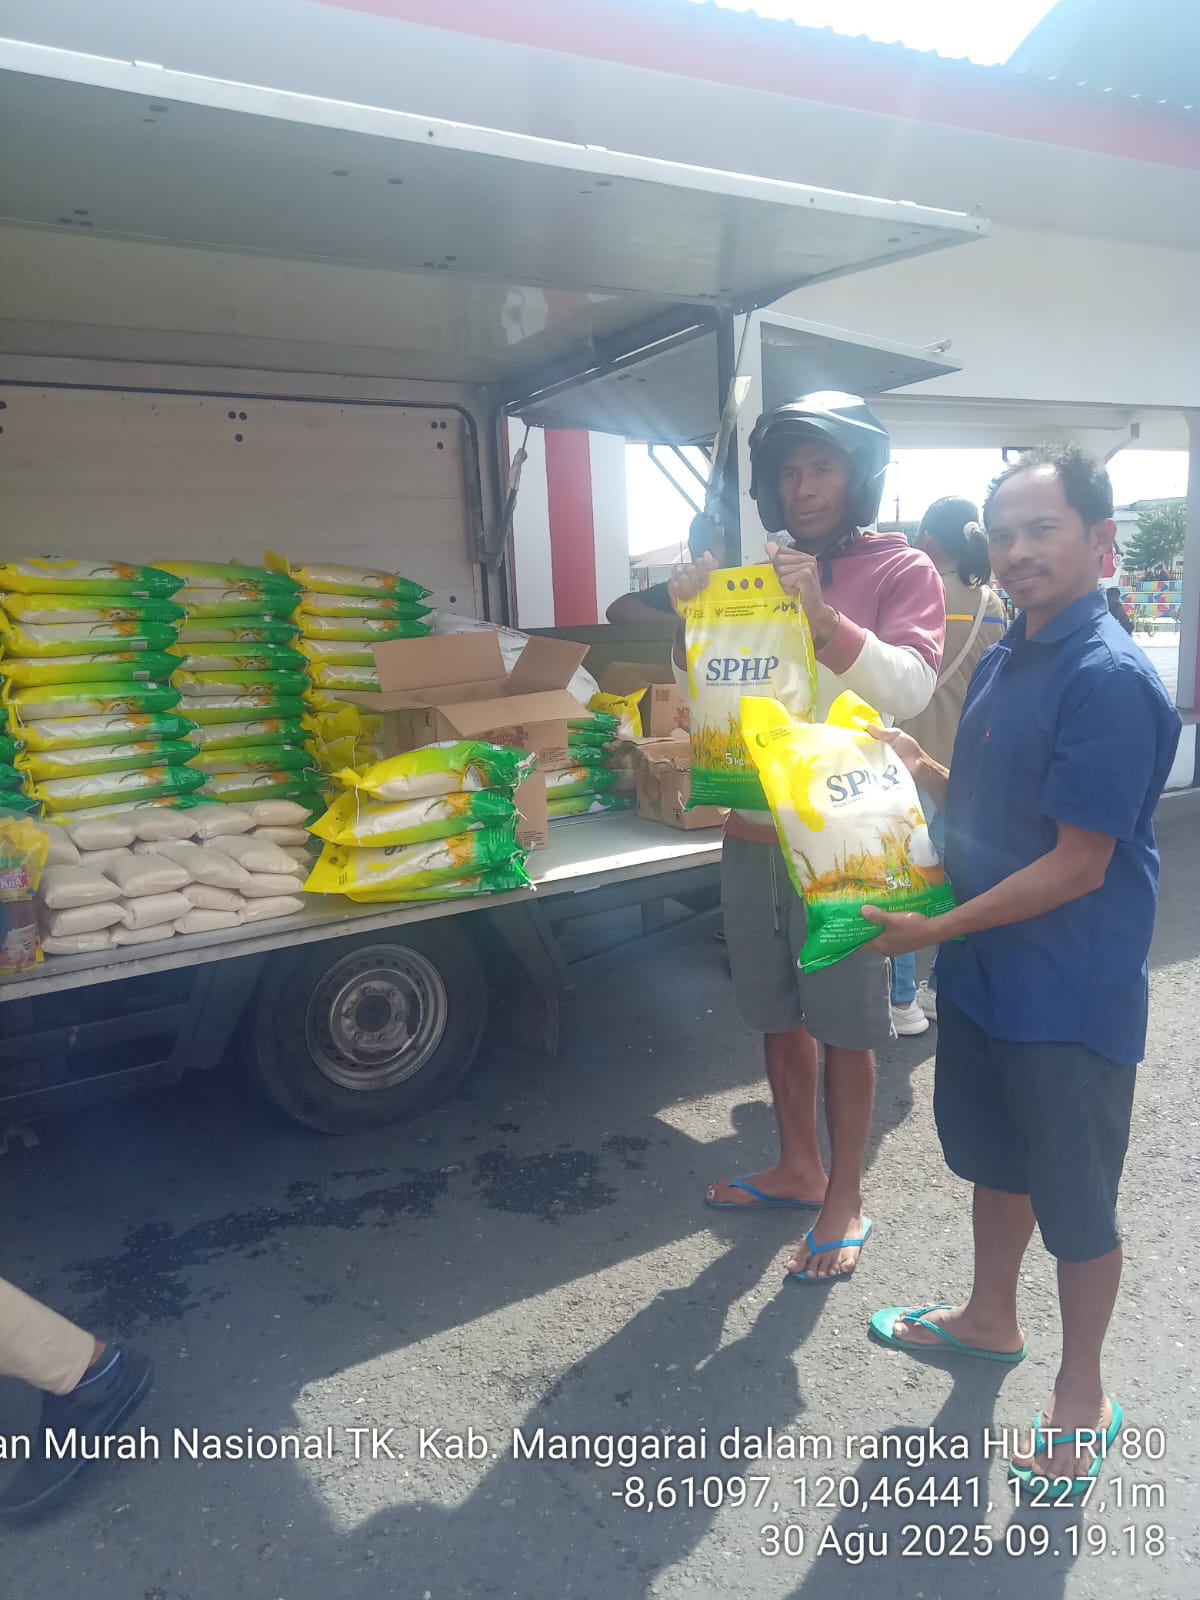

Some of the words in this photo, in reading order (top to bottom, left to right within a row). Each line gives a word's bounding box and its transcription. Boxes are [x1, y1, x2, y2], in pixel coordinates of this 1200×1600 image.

[705, 655, 779, 681] SPHP
[725, 752, 733, 765] 5
[826, 764, 900, 802] SPP
[886, 876, 898, 890] 5
